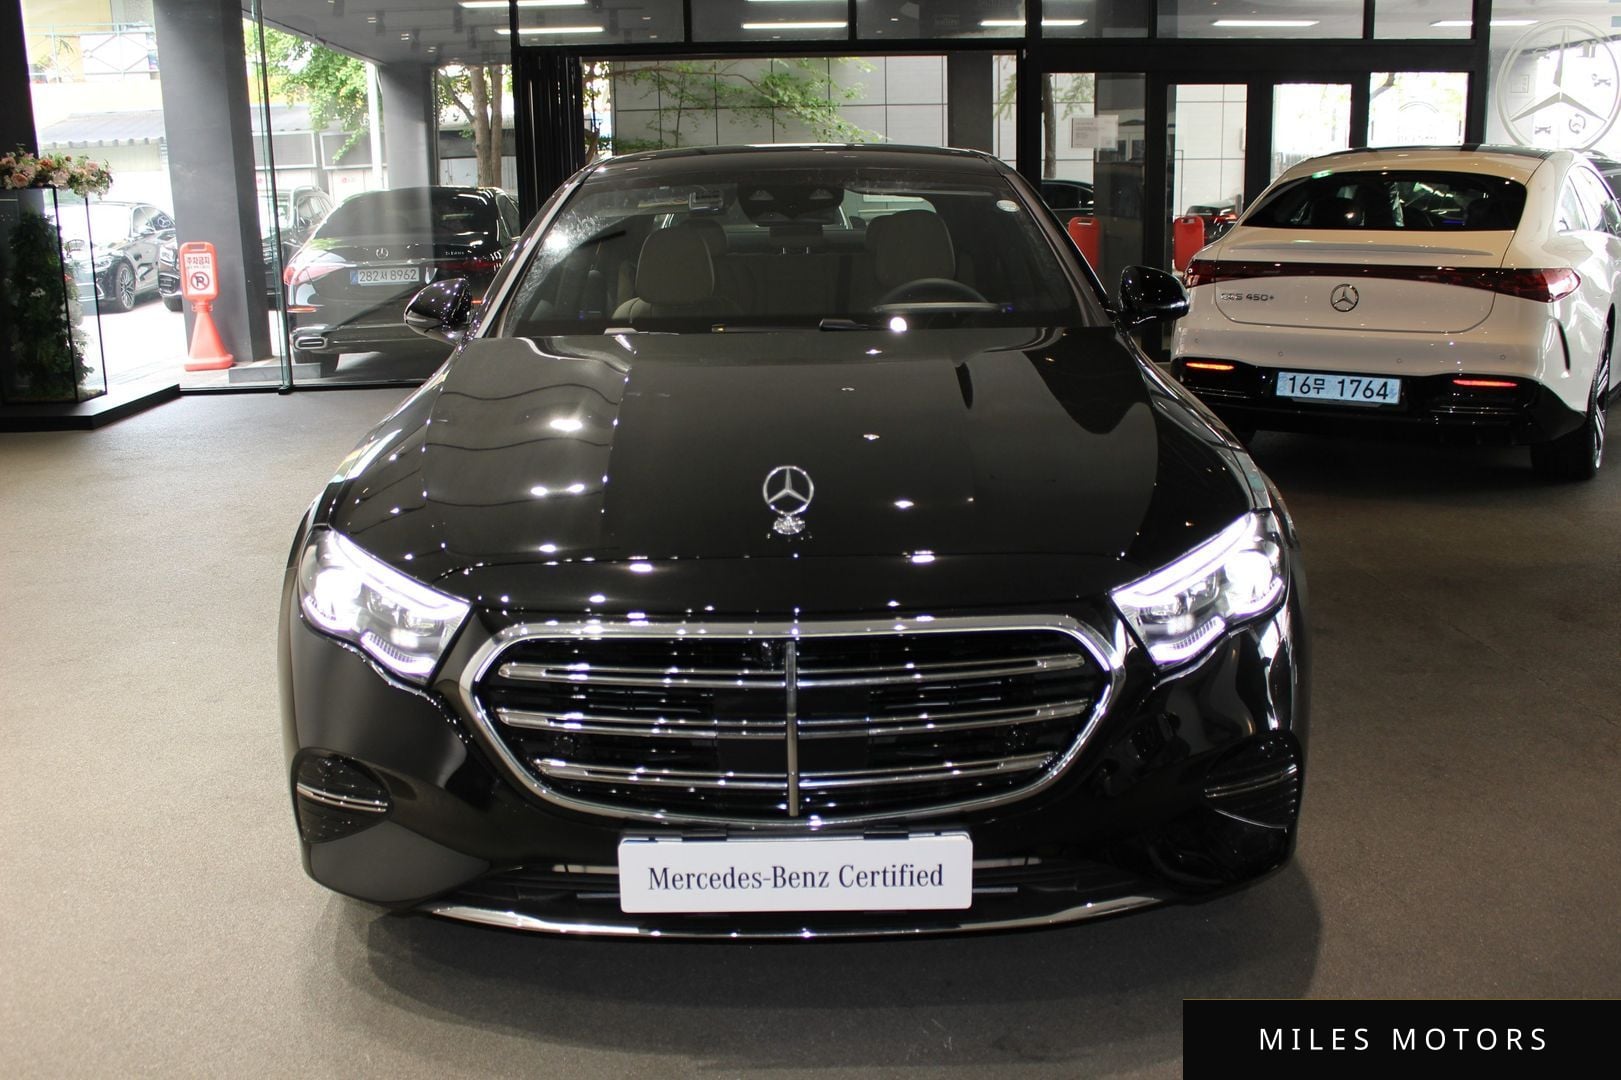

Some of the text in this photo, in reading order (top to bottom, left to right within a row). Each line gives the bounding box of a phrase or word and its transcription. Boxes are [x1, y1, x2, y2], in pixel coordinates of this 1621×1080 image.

[187, 256, 210, 265] 주차금지
[359, 269, 417, 282] 282서 8962
[1289, 375, 1389, 400] 16무 1764
[648, 863, 945, 891] Mercedes-Benz Certified
